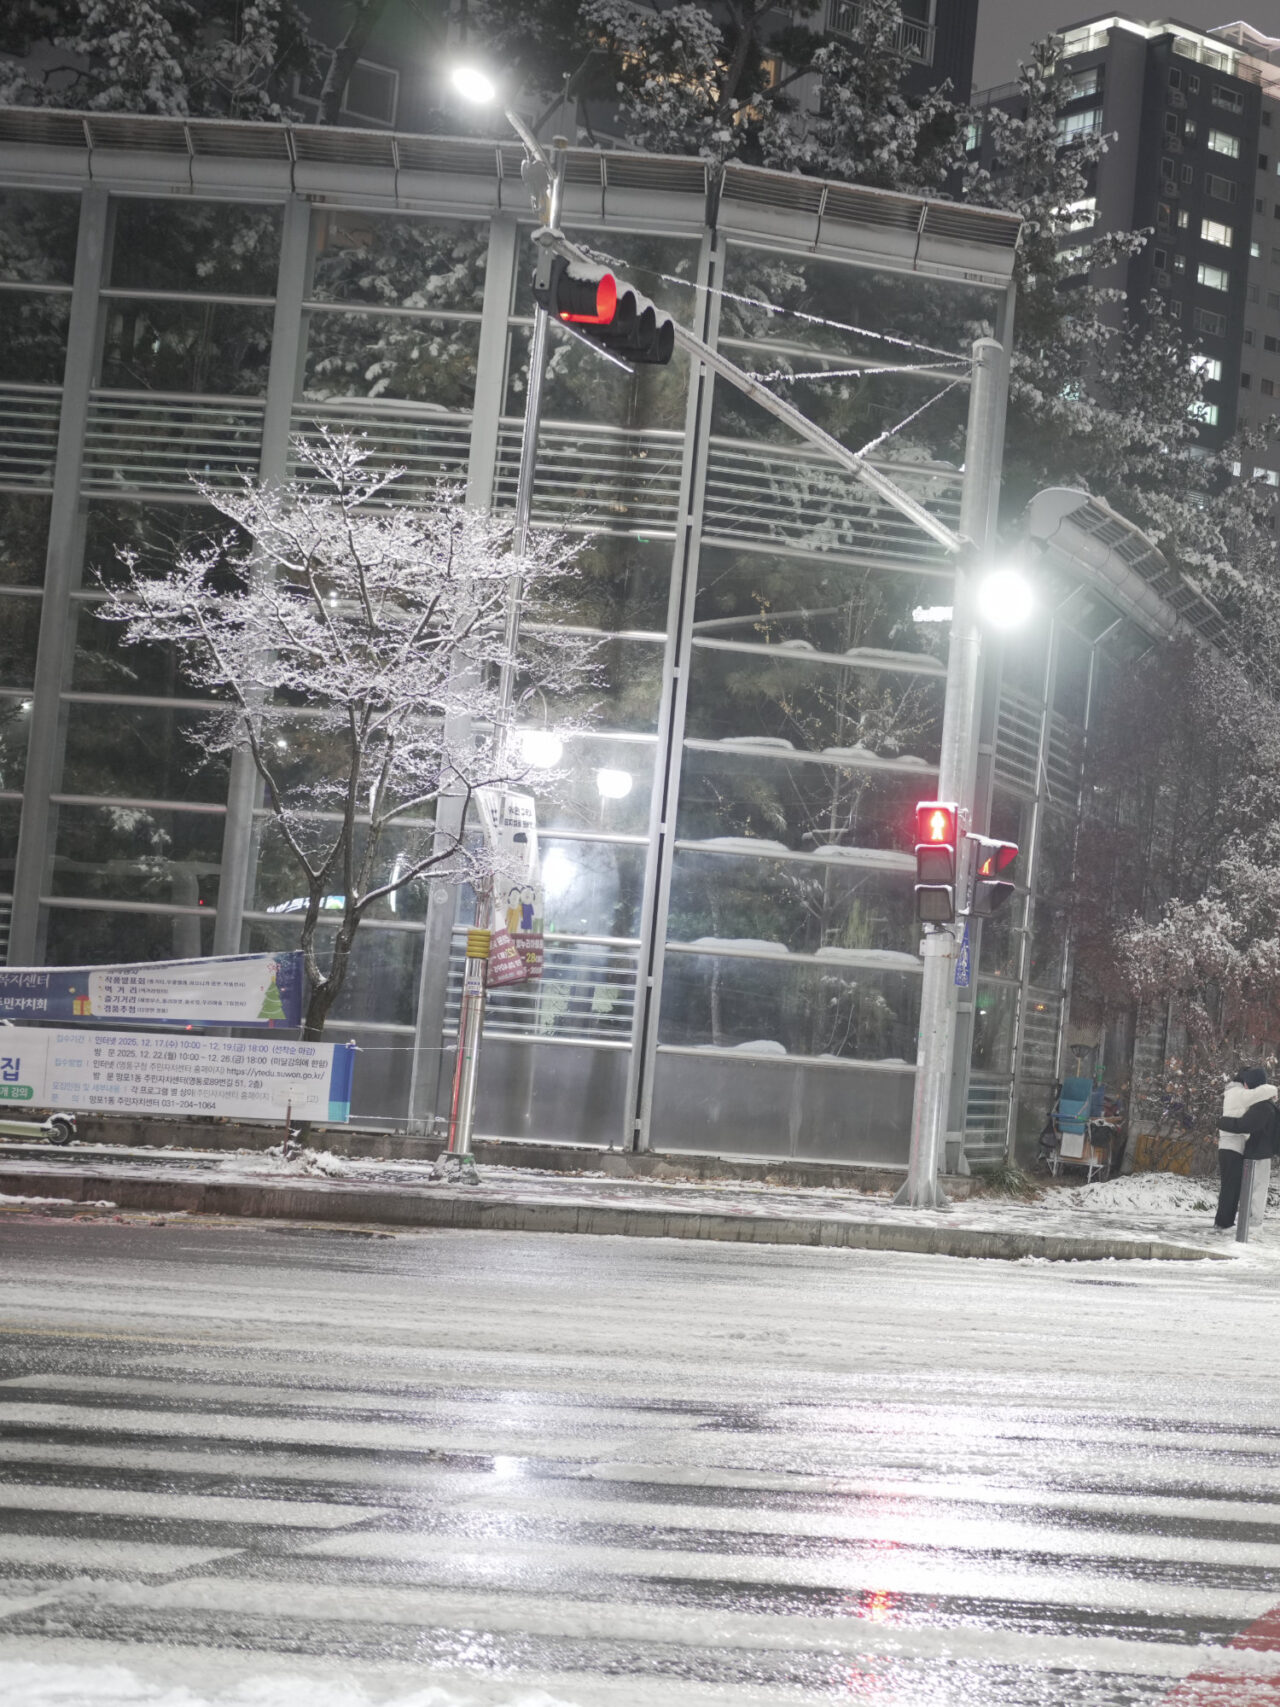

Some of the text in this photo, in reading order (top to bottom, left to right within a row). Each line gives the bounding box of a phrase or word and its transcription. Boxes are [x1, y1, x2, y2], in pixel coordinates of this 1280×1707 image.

[0, 997, 48, 1011] 민자치회
[95, 1036, 116, 1045] 인터넷
[118, 1038, 138, 1046] 2025.
[181, 1041, 200, 1049] 10:00
[248, 1044, 268, 1052] 18:00
[272, 1045, 296, 1054] (선착순
[298, 1047, 316, 1056] 마감)
[117, 1050, 137, 1058] 2025.
[180, 1052, 200, 1060] 10:00
[248, 1056, 268, 1064] 18:00
[0, 1057, 20, 1082] 집
[93, 1060, 114, 1069] 인터넷
[150, 1062, 192, 1072] 주민자치센터
[116, 1073, 142, 1082] 망포1동
[12, 1088, 28, 1098] 강의
[130, 1086, 138, 1094] 각
[140, 1086, 168, 1096] 프로그램
[90, 1095, 114, 1104] 망포1동
[118, 1097, 160, 1107] 주민자치센터
[162, 1100, 216, 1110] 031-204-1064
